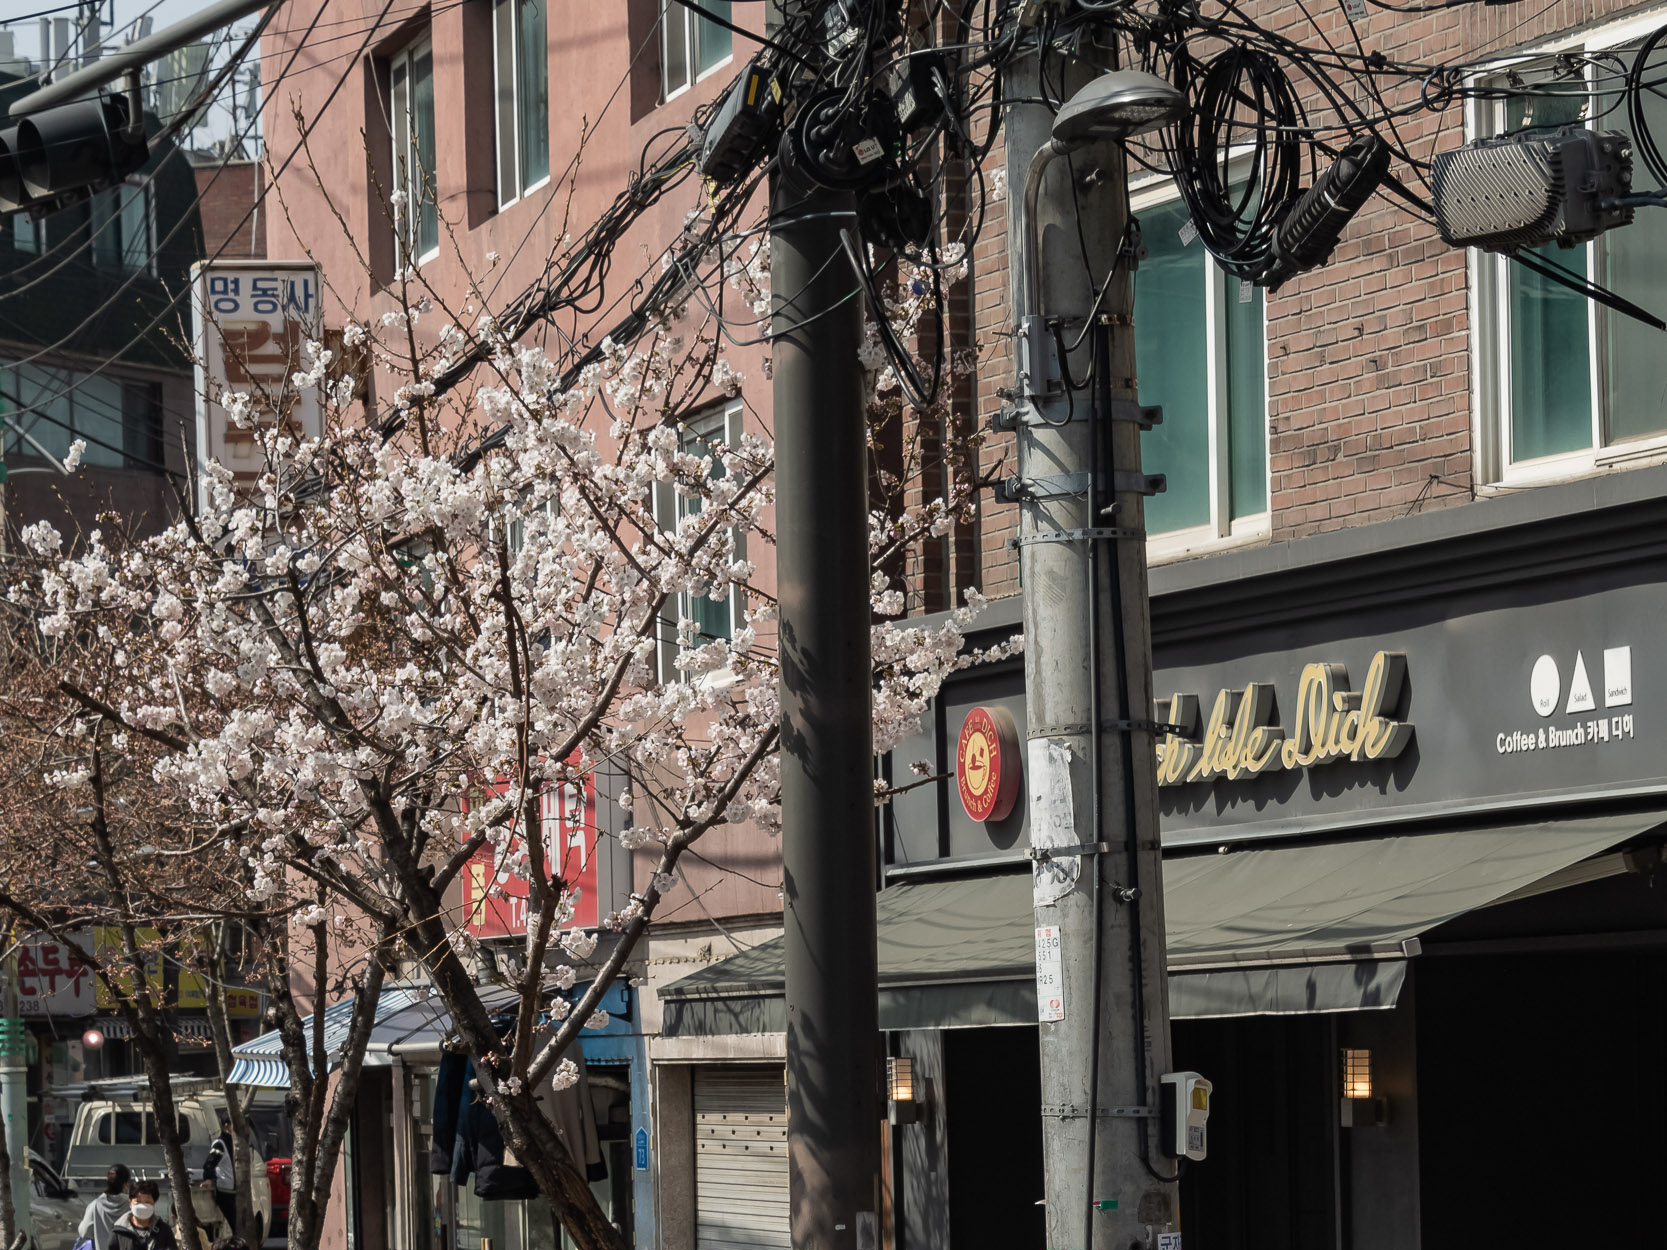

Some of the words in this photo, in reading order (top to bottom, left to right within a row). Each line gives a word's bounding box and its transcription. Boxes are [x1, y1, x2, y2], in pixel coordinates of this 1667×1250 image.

[209, 276, 314, 315] 명동사
[1281, 651, 1398, 770] Dich
[1573, 694, 1588, 703] Salad
[1607, 686, 1628, 697] Sandwich
[959, 719, 973, 763] CAFE
[981, 718, 997, 759] DICH
[1496, 729, 1536, 754] Coffee
[1537, 728, 1546, 749] &
[1548, 721, 1585, 748] Brunch
[1586, 718, 1609, 742] 카페
[960, 775, 977, 813] Brunch
[977, 800, 983, 813] &
[982, 771, 997, 808] Coffee
